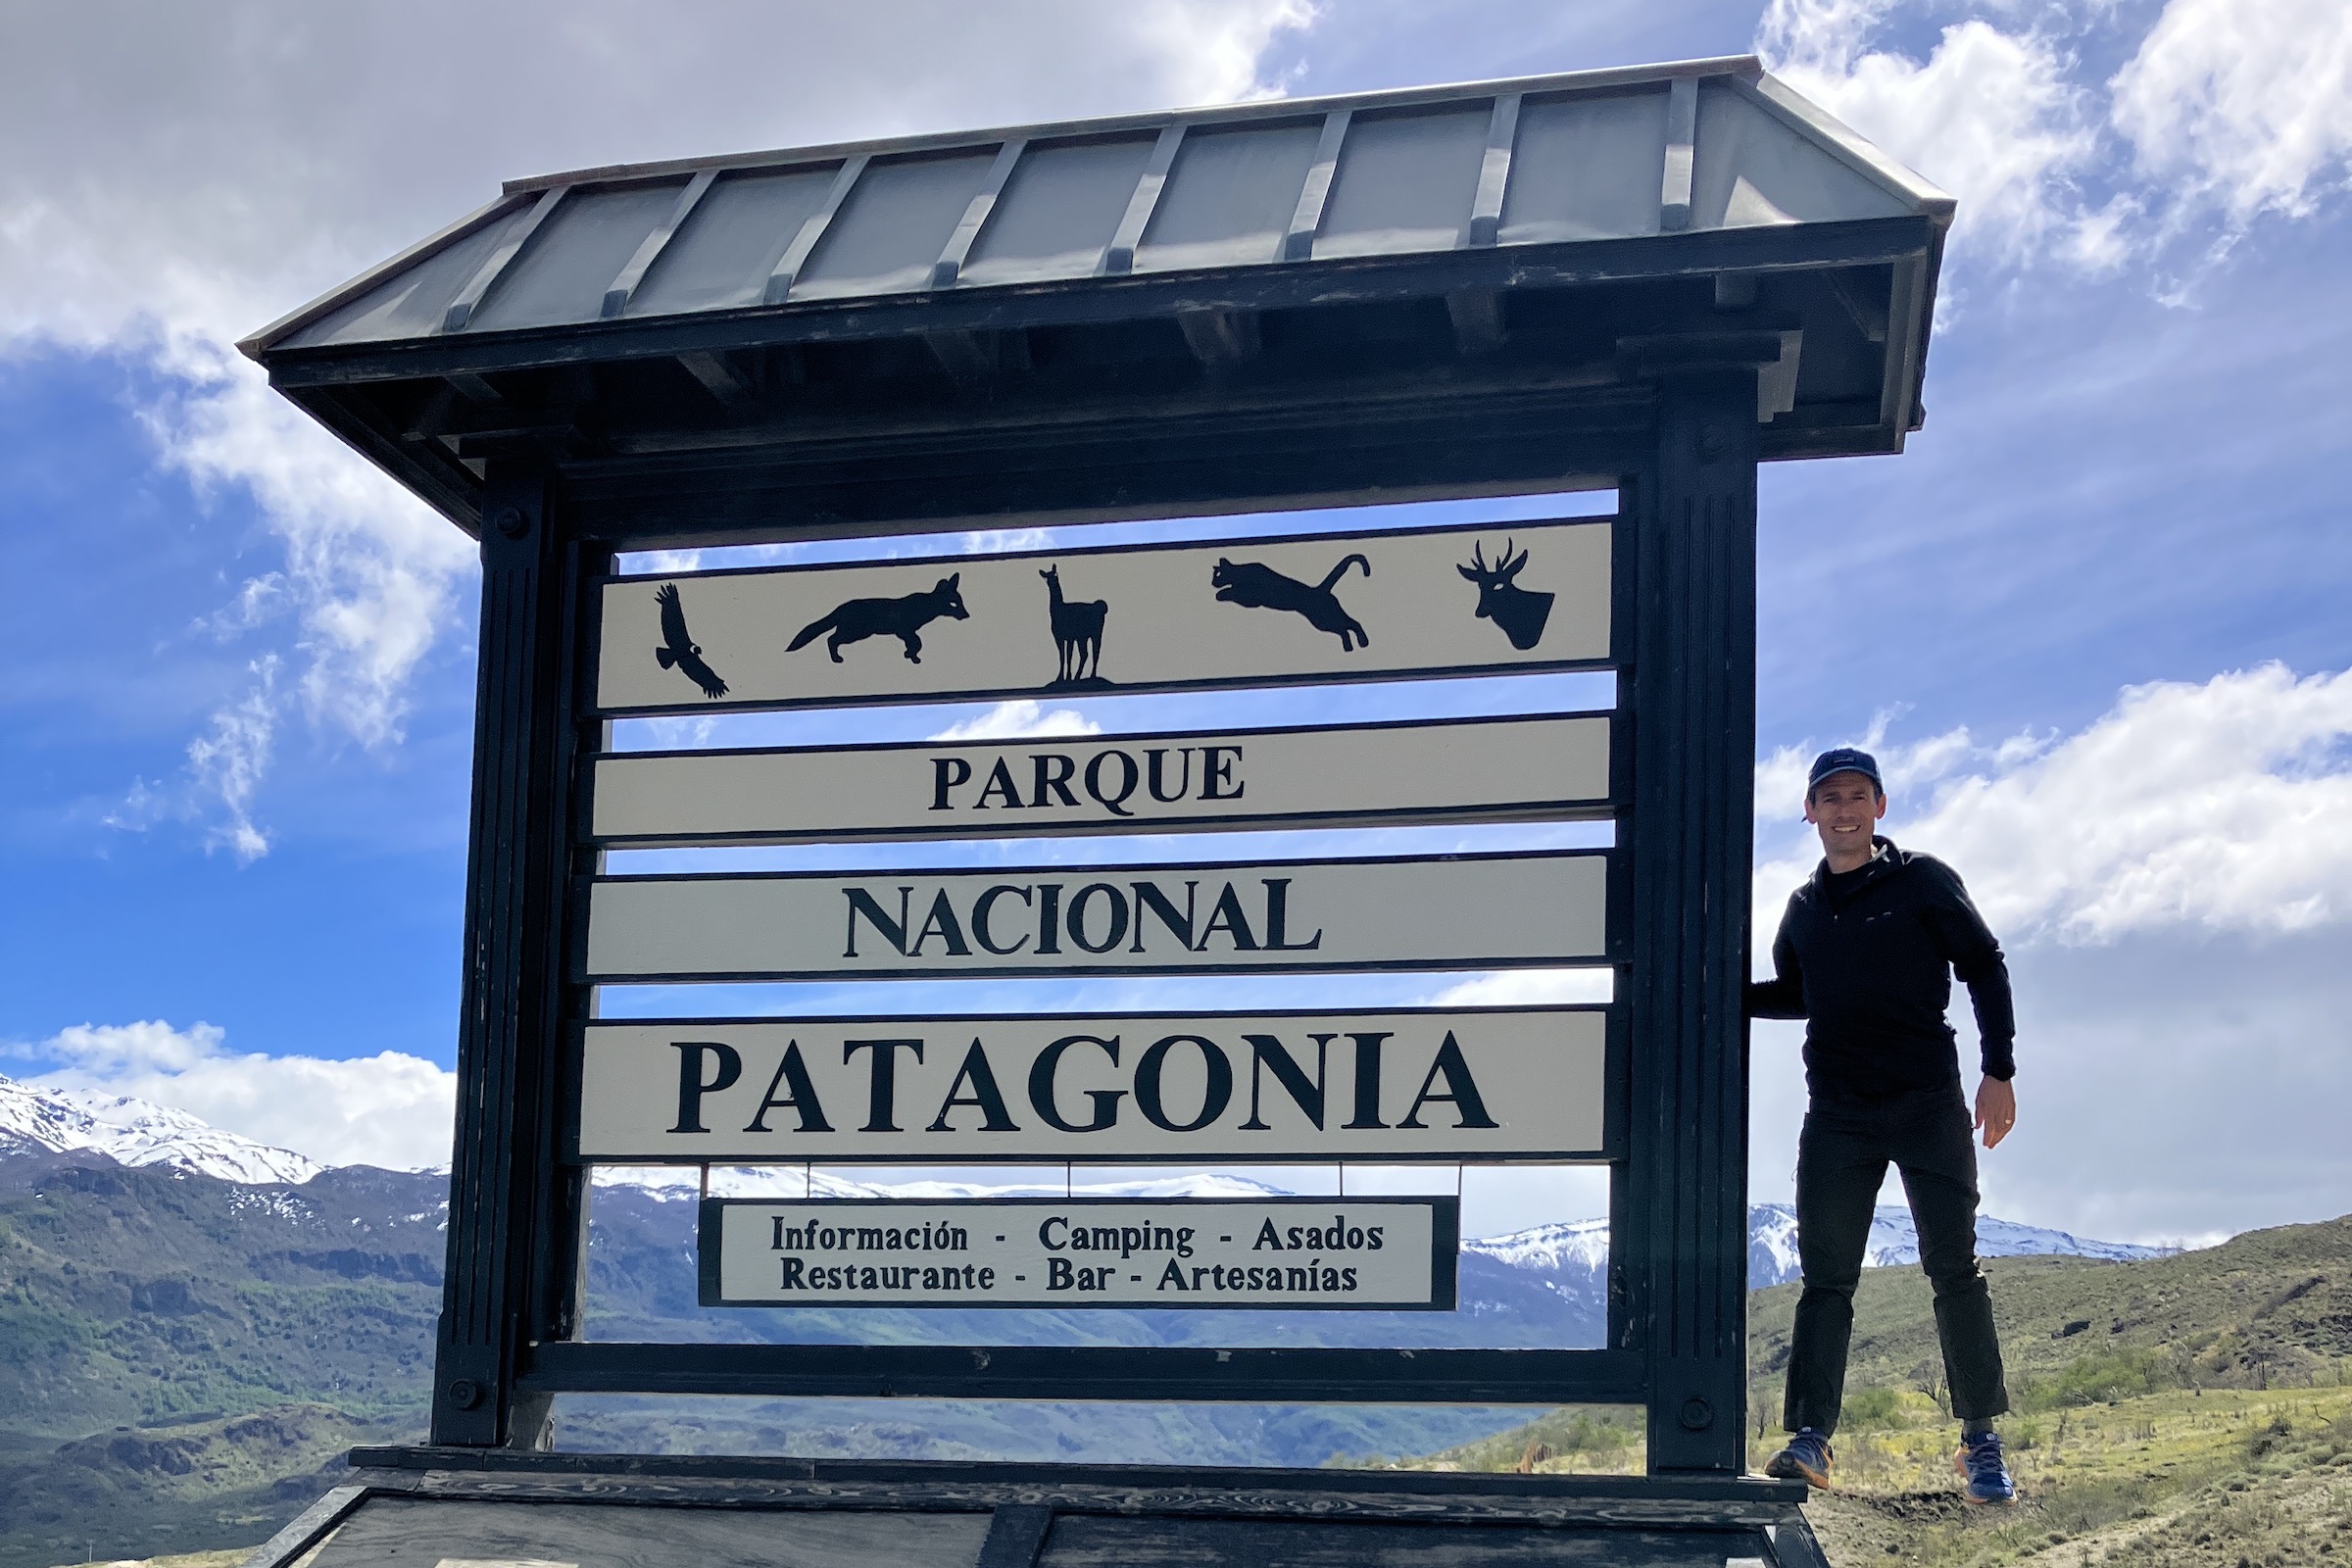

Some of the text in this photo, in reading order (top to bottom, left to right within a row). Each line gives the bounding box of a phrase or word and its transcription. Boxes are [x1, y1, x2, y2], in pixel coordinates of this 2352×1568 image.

[928, 746, 1245, 816] PARQUE
[842, 878, 1323, 958] NACIONAL
[666, 1029, 1499, 1134] PATAGONIA
[771, 1216, 968, 1251] Información
[1039, 1216, 1196, 1259] Camping
[1251, 1215, 1384, 1250] Asados
[780, 1256, 995, 1291] Restaurante
[1046, 1257, 1116, 1292] Bar
[1156, 1256, 1357, 1292] Artesanías
